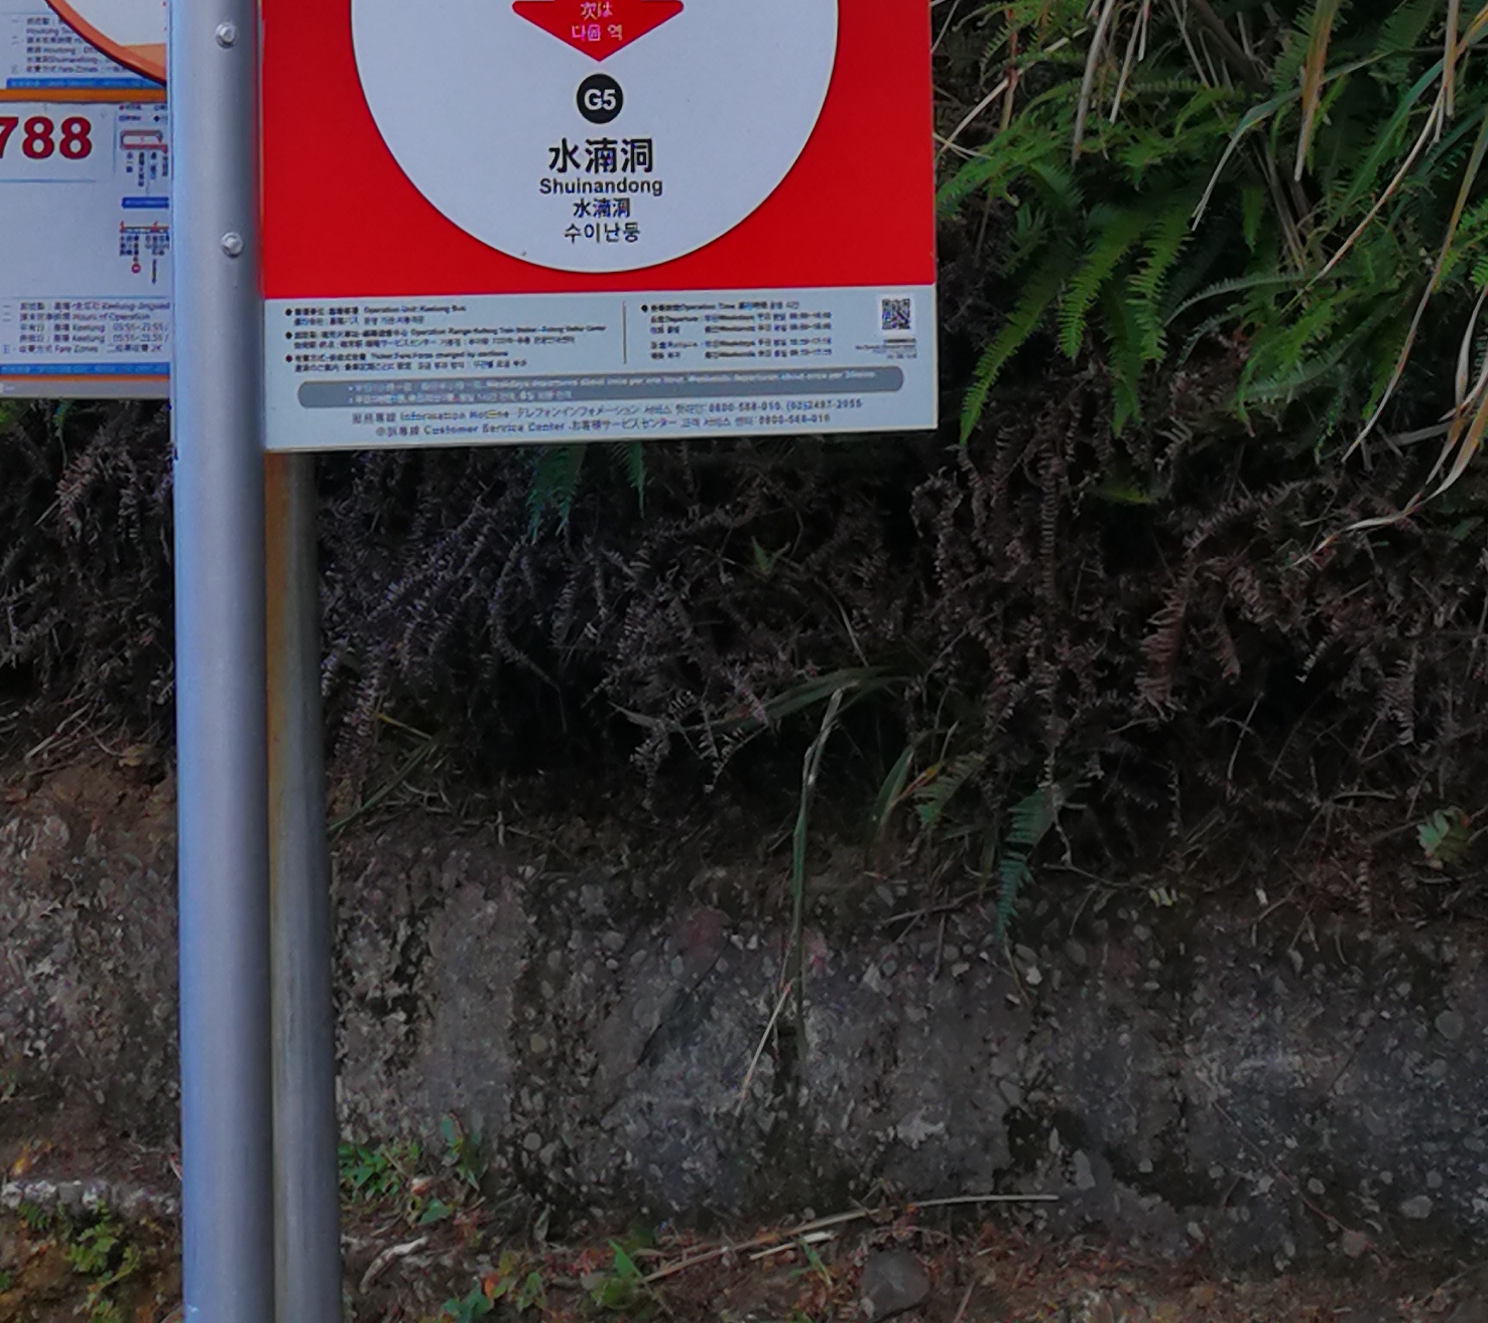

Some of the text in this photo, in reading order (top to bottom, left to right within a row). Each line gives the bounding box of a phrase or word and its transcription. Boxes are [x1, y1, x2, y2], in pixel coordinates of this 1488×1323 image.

[580, 1, 613, 21] 次は
[584, 88, 617, 111] G5
[548, 137, 654, 174] 水湳洞
[539, 177, 663, 197] Shuinandong
[573, 198, 631, 218] 水湳洞
